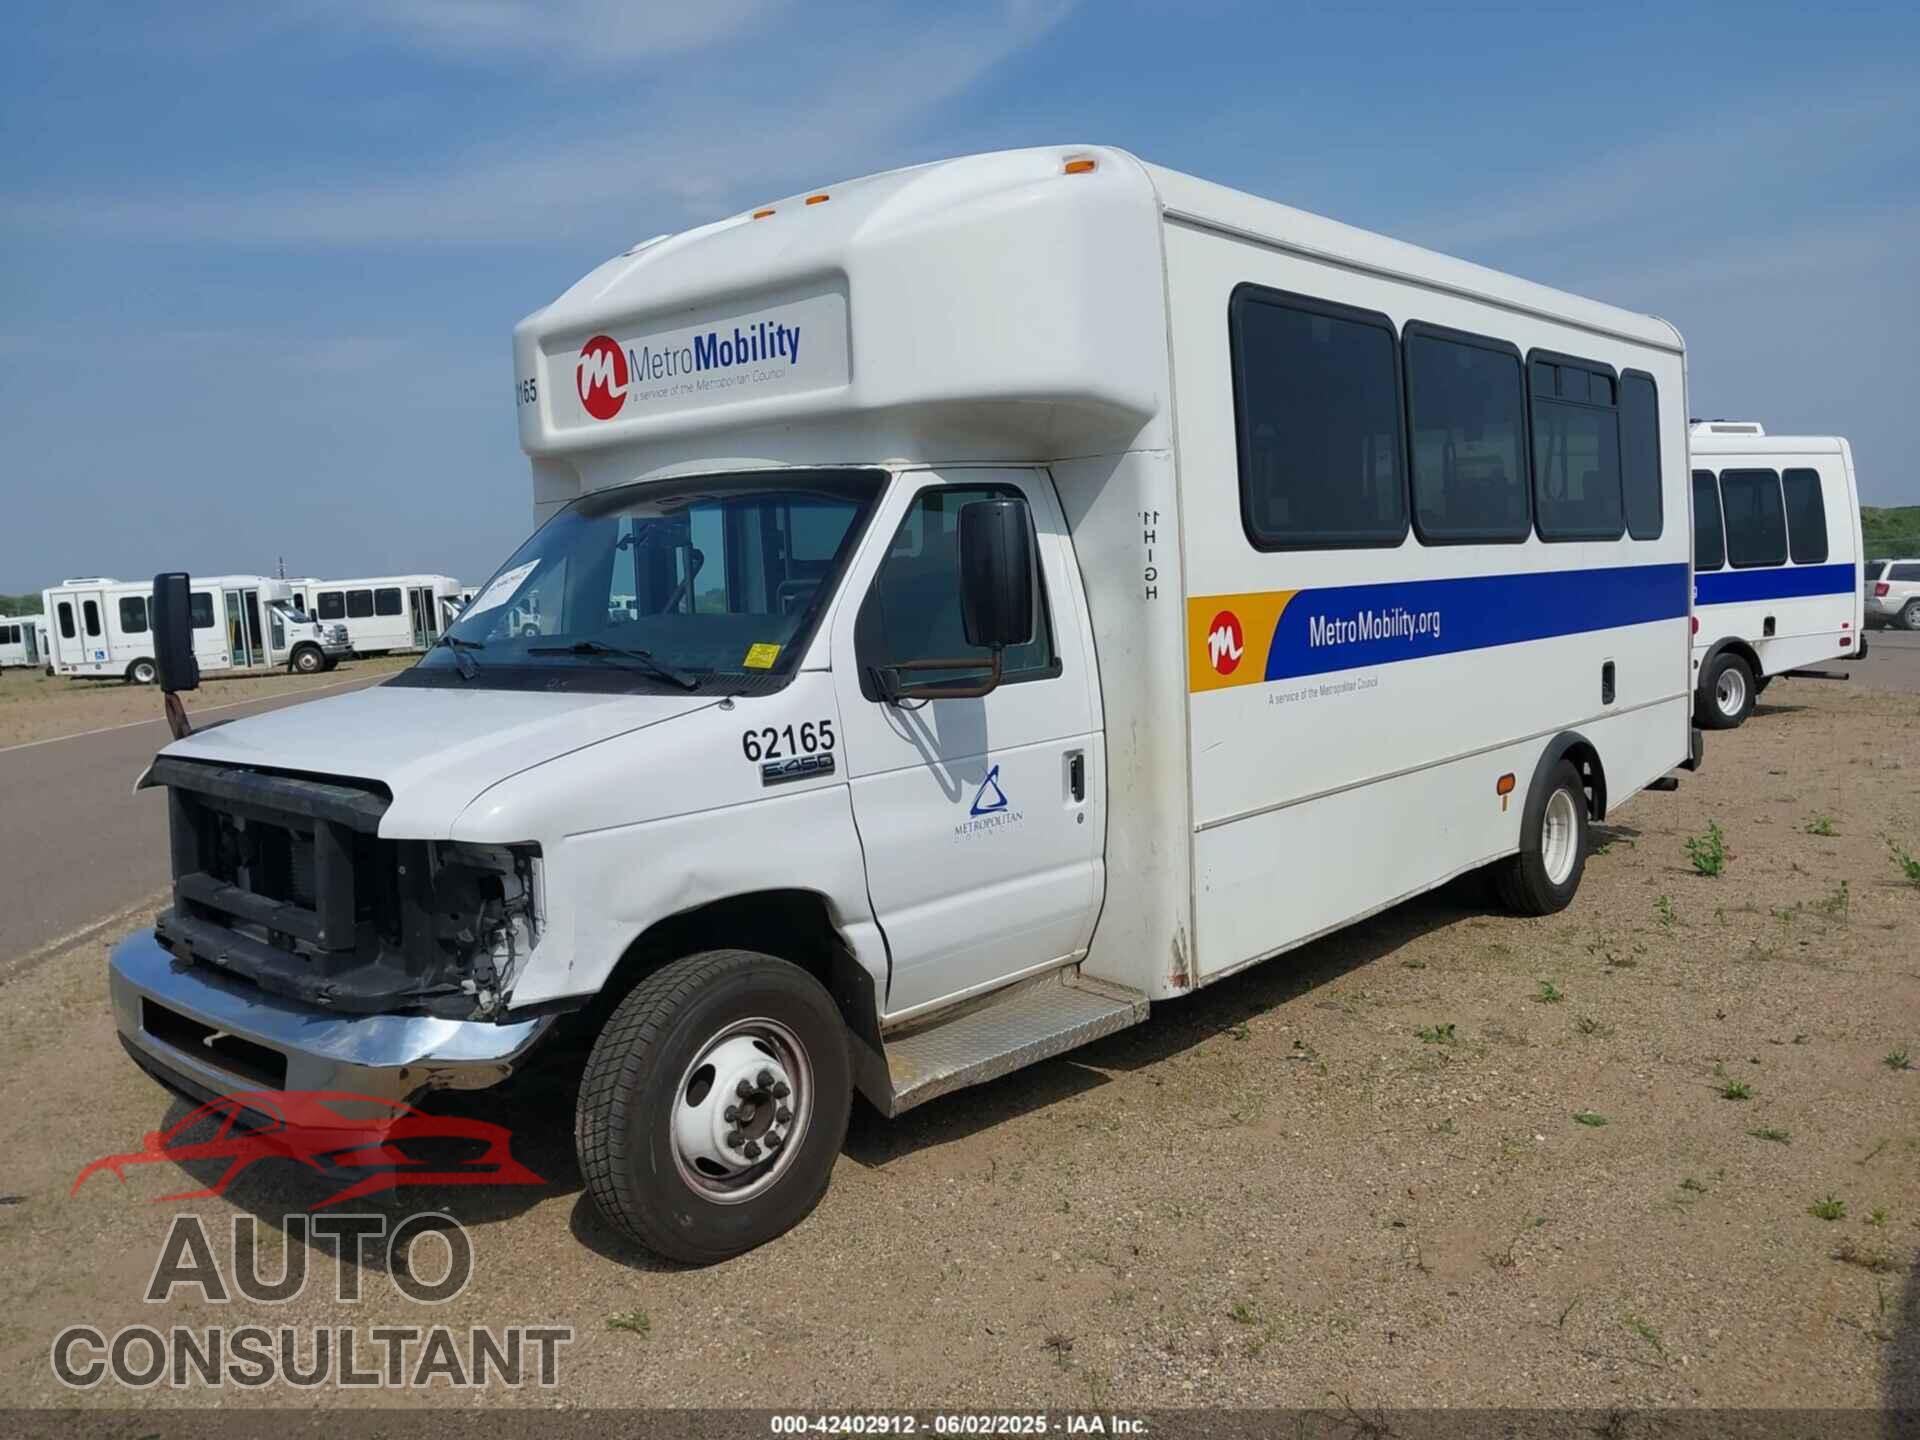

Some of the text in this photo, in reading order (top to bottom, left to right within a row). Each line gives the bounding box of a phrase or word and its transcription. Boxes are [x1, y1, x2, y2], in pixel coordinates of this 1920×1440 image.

[630, 321, 801, 383] MetroMobility
[1309, 608, 1441, 648] MetroMobility.org
[743, 719, 836, 762] 62165
[954, 811, 1023, 835] METROPOLITAN
